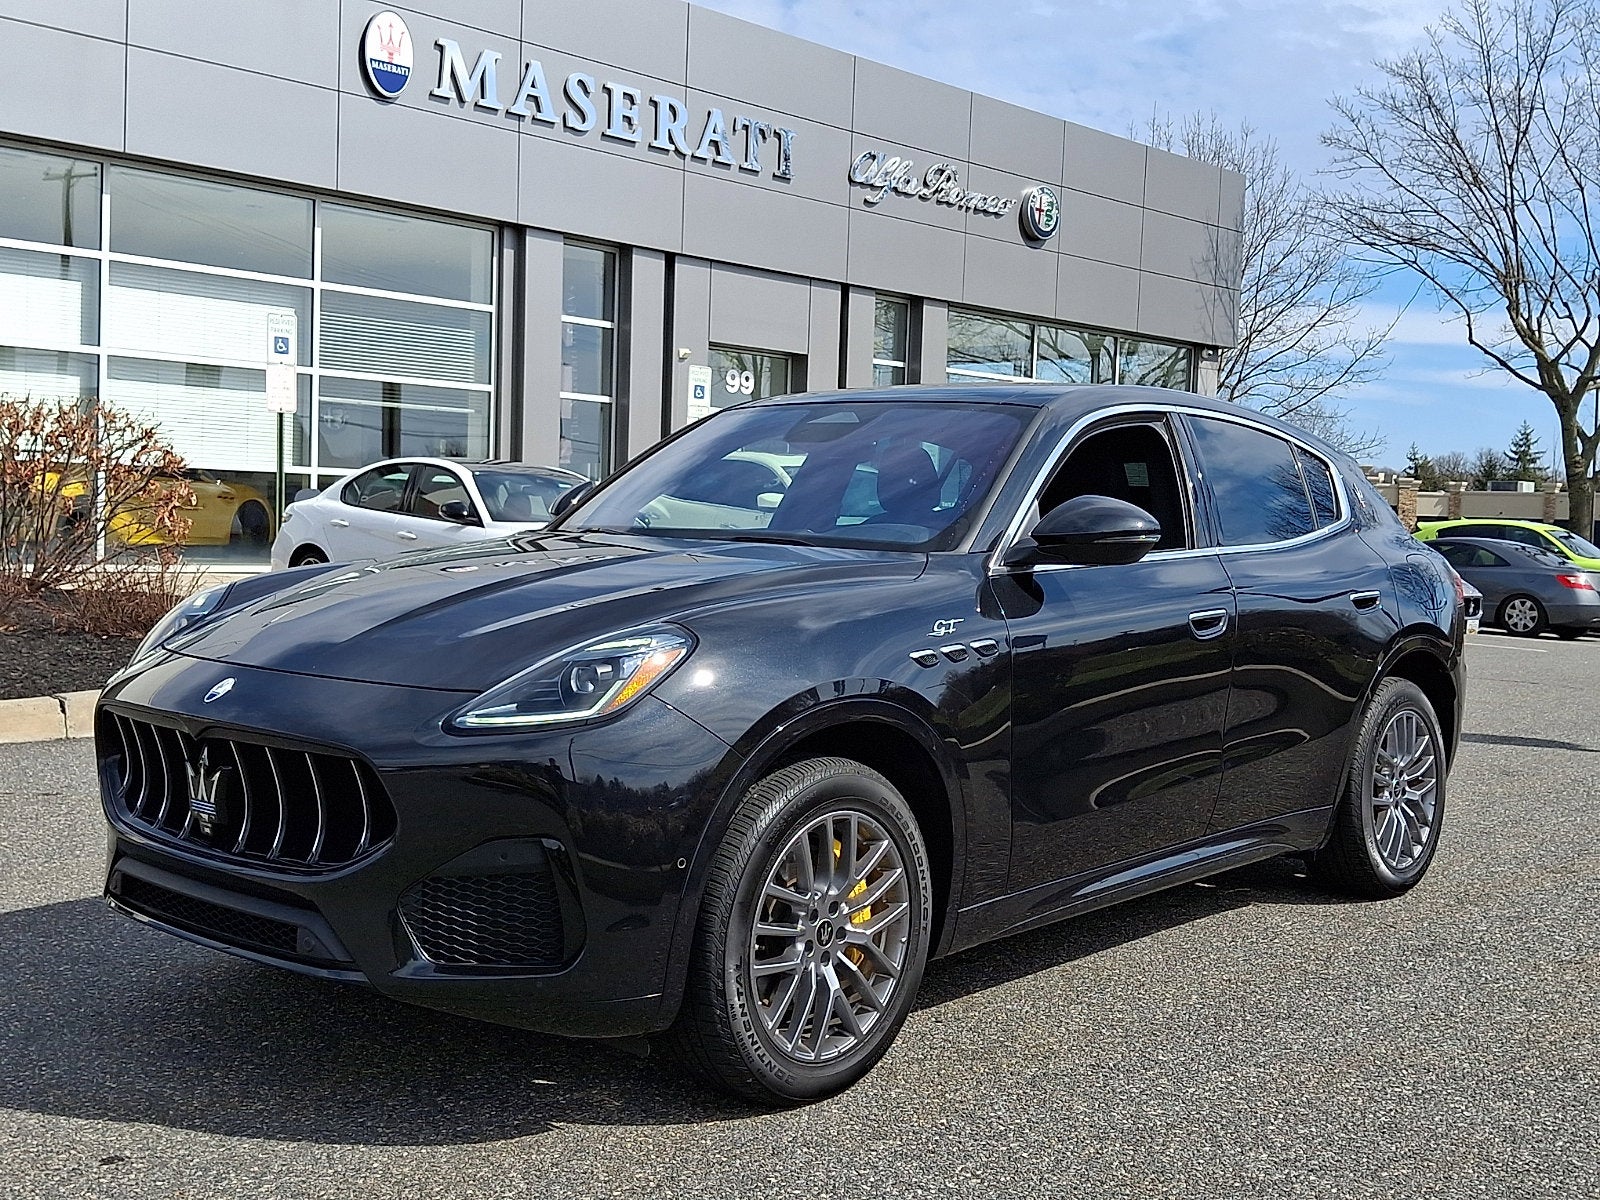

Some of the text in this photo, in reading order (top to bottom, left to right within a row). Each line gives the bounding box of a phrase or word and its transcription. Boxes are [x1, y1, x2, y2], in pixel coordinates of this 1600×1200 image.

[371, 60, 409, 76] MASERATI
[431, 37, 799, 180] MASERATI
[849, 151, 921, 205] Alfa
[919, 163, 1017, 216] Romeo
[725, 369, 755, 395] 99
[926, 618, 965, 637] GT
[879, 796, 929, 936] CROSSCONTACT
[735, 955, 796, 1087] CONTINENTAL
